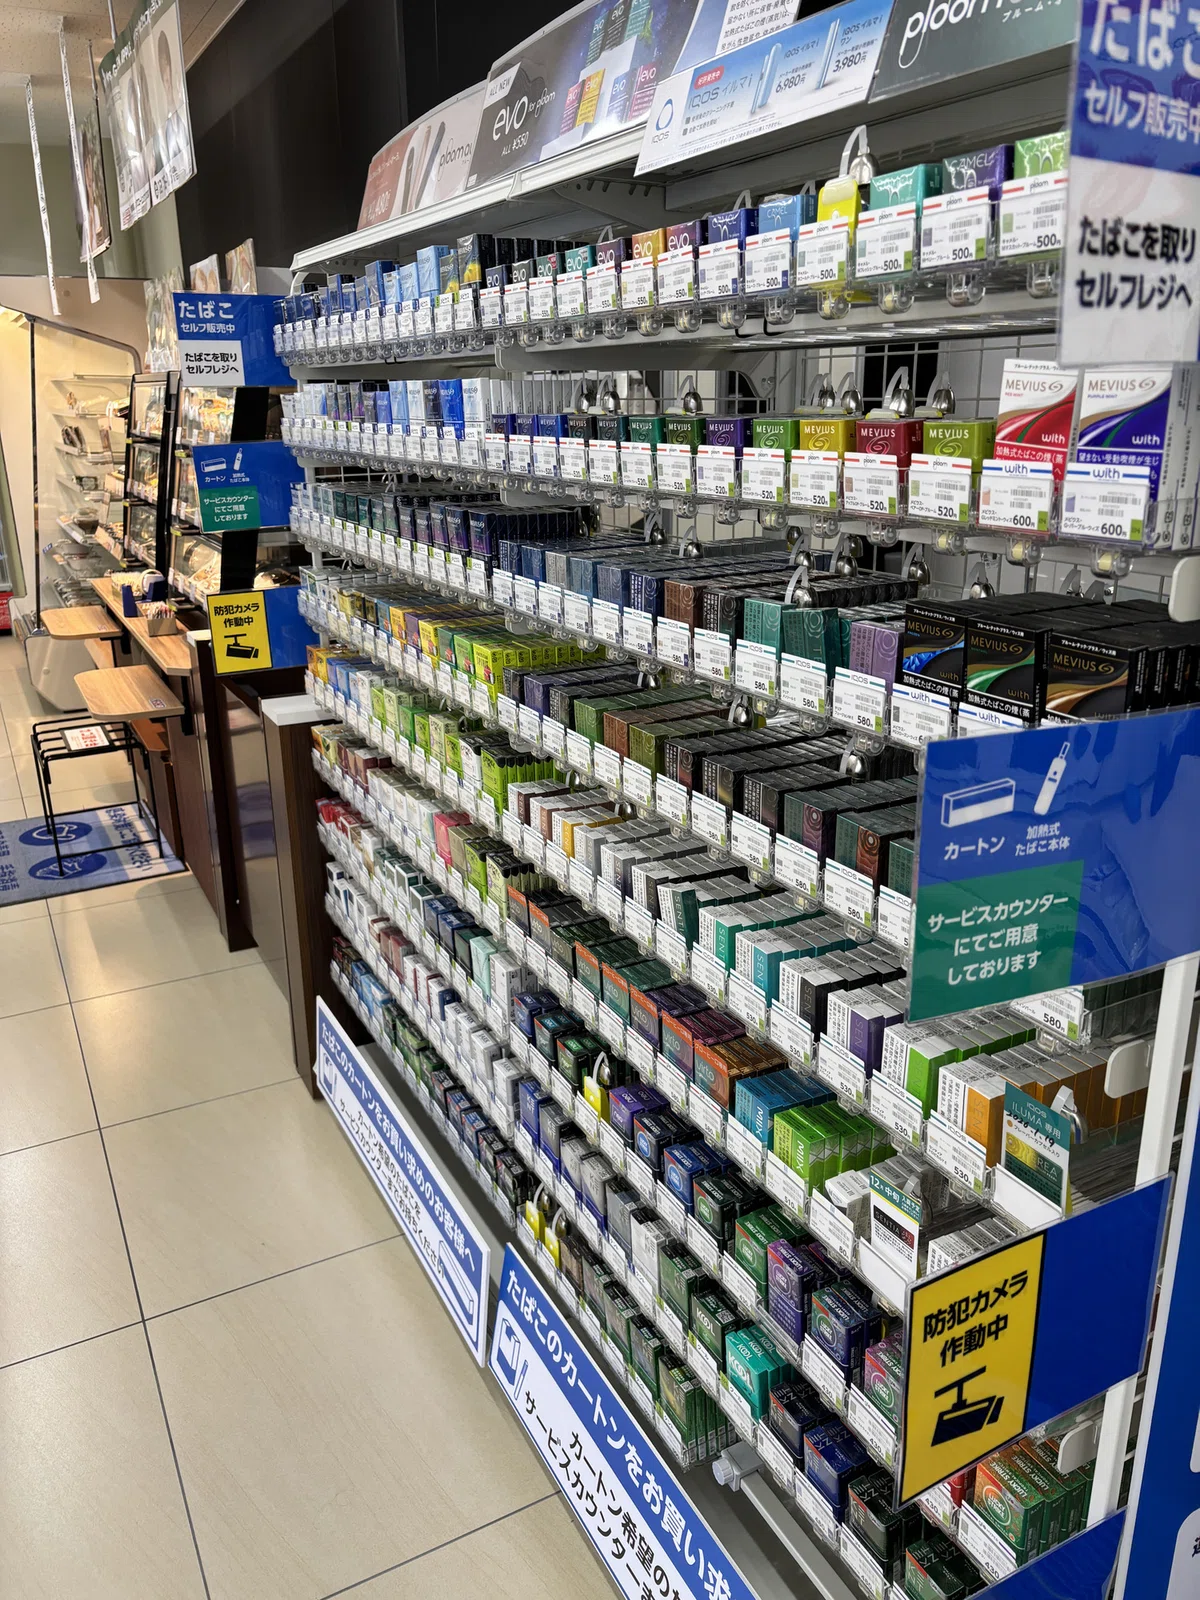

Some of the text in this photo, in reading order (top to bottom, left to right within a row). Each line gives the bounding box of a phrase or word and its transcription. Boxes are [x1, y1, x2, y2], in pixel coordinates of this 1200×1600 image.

[842, 23, 860, 36] IQOS
[784, 47, 799, 59] IQOS
[688, 87, 719, 109] IQOS
[493, 96, 528, 141] evo
[652, 131, 669, 144] IQOS
[1030, 178, 1048, 190] ploom
[947, 196, 962, 210] ploom
[879, 211, 892, 222] ploom
[668, 233, 689, 250] evo
[1077, 214, 1197, 264] たばこを取り
[633, 241, 652, 257] evo
[567, 256, 582, 271] evo
[1075, 269, 1193, 311] セルフレジへ
[179, 301, 233, 318] たばこ
[181, 323, 235, 333] セルフ販売中
[185, 353, 237, 362] たばこを取り
[186, 365, 239, 374] セルフレジへ
[1005, 378, 1046, 392] MEVIUS
[1088, 380, 1136, 392] MEVIUS
[669, 423, 691, 431] MEVIUS
[709, 424, 734, 432] MEVIUS
[756, 425, 784, 434] MEVIUS
[804, 425, 835, 435] MEVIUS
[861, 428, 895, 438] MEVIUS
[929, 428, 969, 439] MEVIUS
[1042, 434, 1065, 444] with
[1132, 435, 1160, 445] with
[864, 456, 876, 467] ploom
[933, 457, 948, 470] ploom
[1079, 453, 1159, 466] 望まない受動喫煙が生じ
[1004, 464, 1028, 474] with
[1093, 468, 1120, 479] with
[204, 495, 254, 505] サービスカウンター
[214, 514, 248, 522] しております
[1013, 515, 1035, 528] 600円
[1101, 523, 1127, 537] 600円
[214, 603, 259, 616] 防犯カメラ
[224, 617, 253, 628] 作動中
[908, 620, 940, 636] MEVIUS
[749, 645, 762, 653] IQOS
[971, 636, 1007, 651] MEVIUS
[796, 659, 811, 668] IQOS
[1053, 653, 1096, 672] MEVIUS
[851, 675, 868, 684] IQOS
[940, 671, 959, 681] with
[911, 691, 930, 703] with
[1008, 688, 1030, 700] with
[979, 711, 1000, 724] with
[744, 819, 757, 830] IQOS
[1027, 822, 1060, 839] 加熱式
[789, 842, 804, 854] IQOS
[944, 836, 1005, 860] カートン
[1015, 837, 1070, 856] たばこ本体
[841, 867, 858, 880] IQOS
[928, 894, 1068, 933] サービスカウンター
[954, 924, 1038, 956] にてご用意
[702, 952, 715, 964] IQOS
[948, 950, 1042, 986] しております
[741, 977, 755, 991] IQOS
[784, 1010, 797, 1024] IQOS
[1042, 1012, 1065, 1033] 580円
[835, 1042, 849, 1059] IQOS
[887, 1083, 905, 1098] IQOS
[1027, 1102, 1047, 1118] IQOS
[1012, 1102, 1061, 1140] ILUMA 専用
[948, 1125, 967, 1142] IQOS
[321, 1022, 476, 1272] たばこのカートンをお買い求めのお客様へ
[954, 1166, 972, 1186] 530円
[876, 1210, 900, 1234] SENTIA
[923, 1269, 1028, 1343] 防犯カメラ
[696, 1307, 715, 1337] KOOL
[940, 1314, 1009, 1368] 作動中
[506, 1269, 732, 1600] たばこのカートンをお買い求
[989, 1460, 1028, 1500] LUCKY STRIKE
